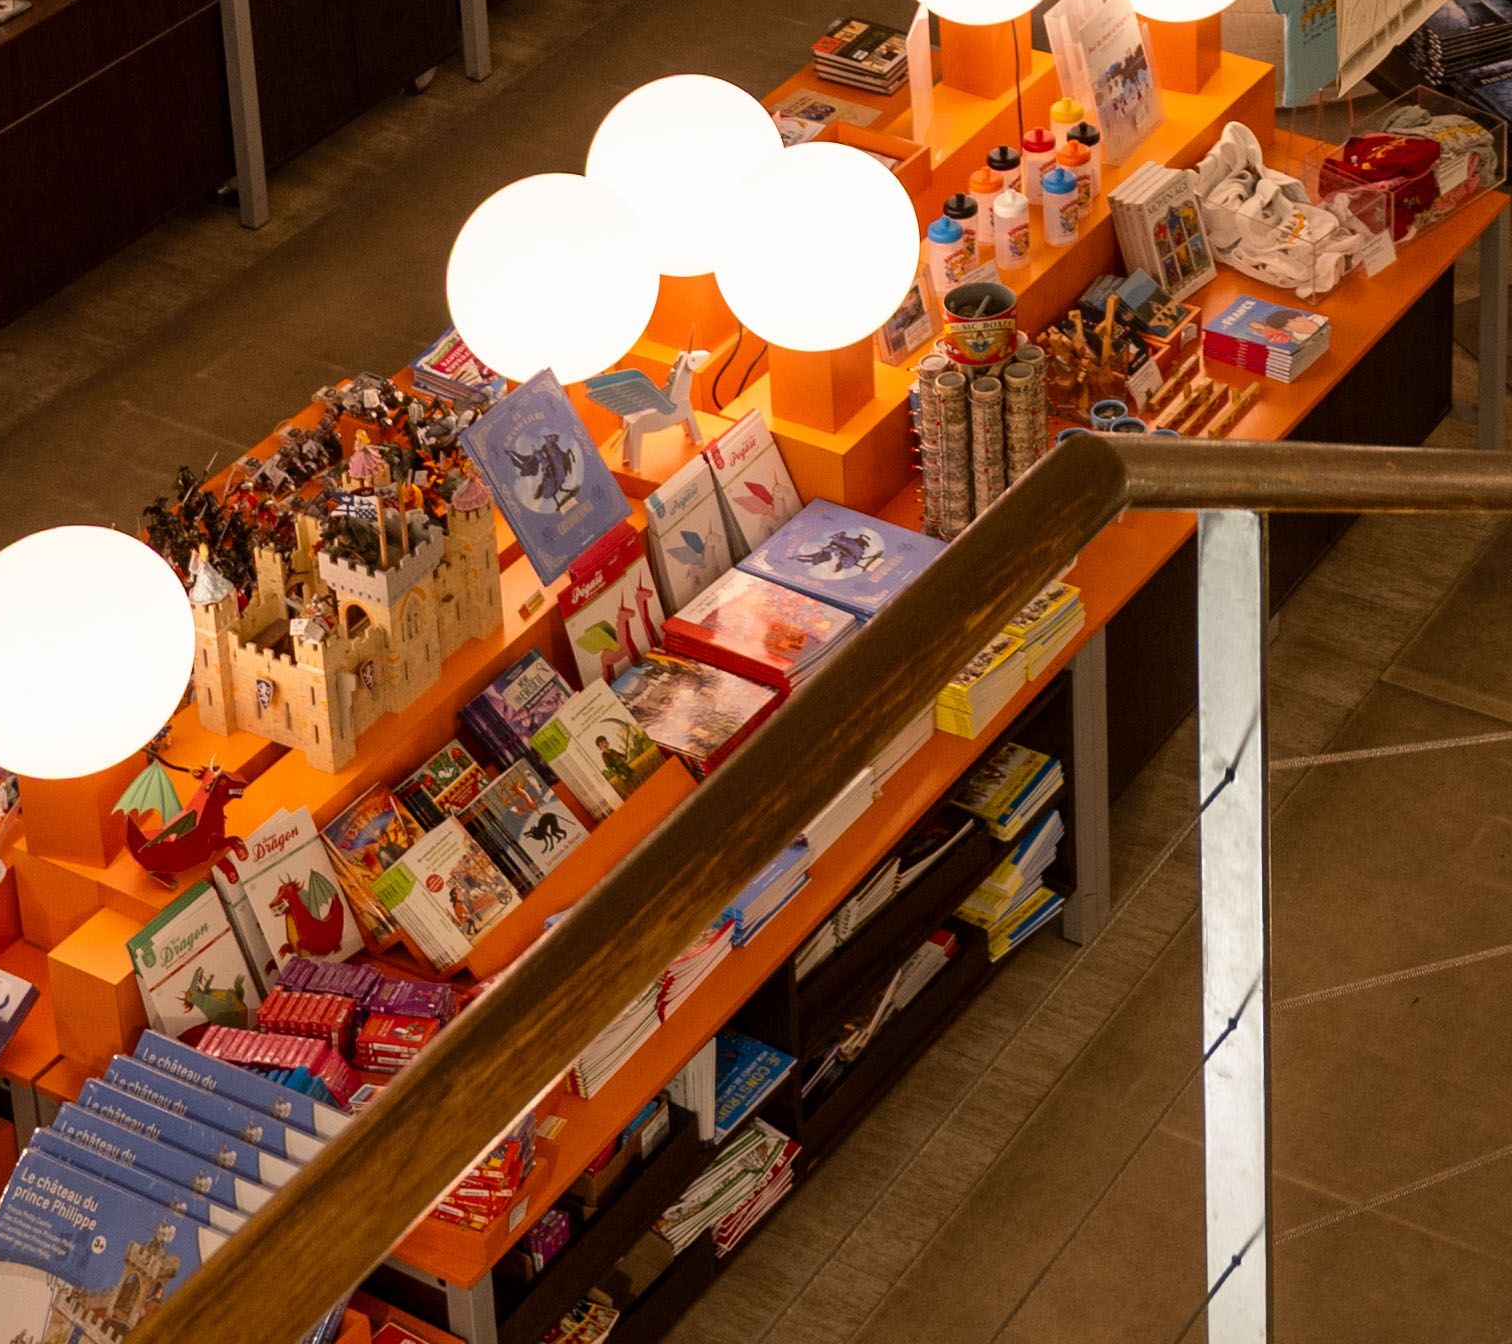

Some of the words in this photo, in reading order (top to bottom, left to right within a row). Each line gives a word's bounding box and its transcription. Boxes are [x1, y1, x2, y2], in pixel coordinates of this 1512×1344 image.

[1145, 193, 1171, 217] MOYEN
[950, 321, 978, 333] MUSIC
[1226, 298, 1257, 328] FRANCE
[251, 825, 300, 863] Dragon
[160, 921, 210, 968] Dragon
[141, 1047, 157, 1064] Le
[157, 1053, 201, 1083] château
[201, 1071, 218, 1091] du
[112, 1071, 127, 1089] Le
[127, 1078, 173, 1109] château
[173, 1098, 189, 1114] du
[85, 1096, 100, 1112] Le
[100, 1103, 145, 1134] château
[145, 1121, 162, 1138] du
[60, 1120, 75, 1136] Le
[75, 1127, 121, 1159] château
[121, 1144, 137, 1163] du
[11, 1184, 50, 1212] prince
[50, 1197, 98, 1232] Philippe
[20, 1167, 36, 1185] Le
[36, 1174, 83, 1204] château
[83, 1195, 100, 1213] du
[92, 1237, 106, 1251] 3+
